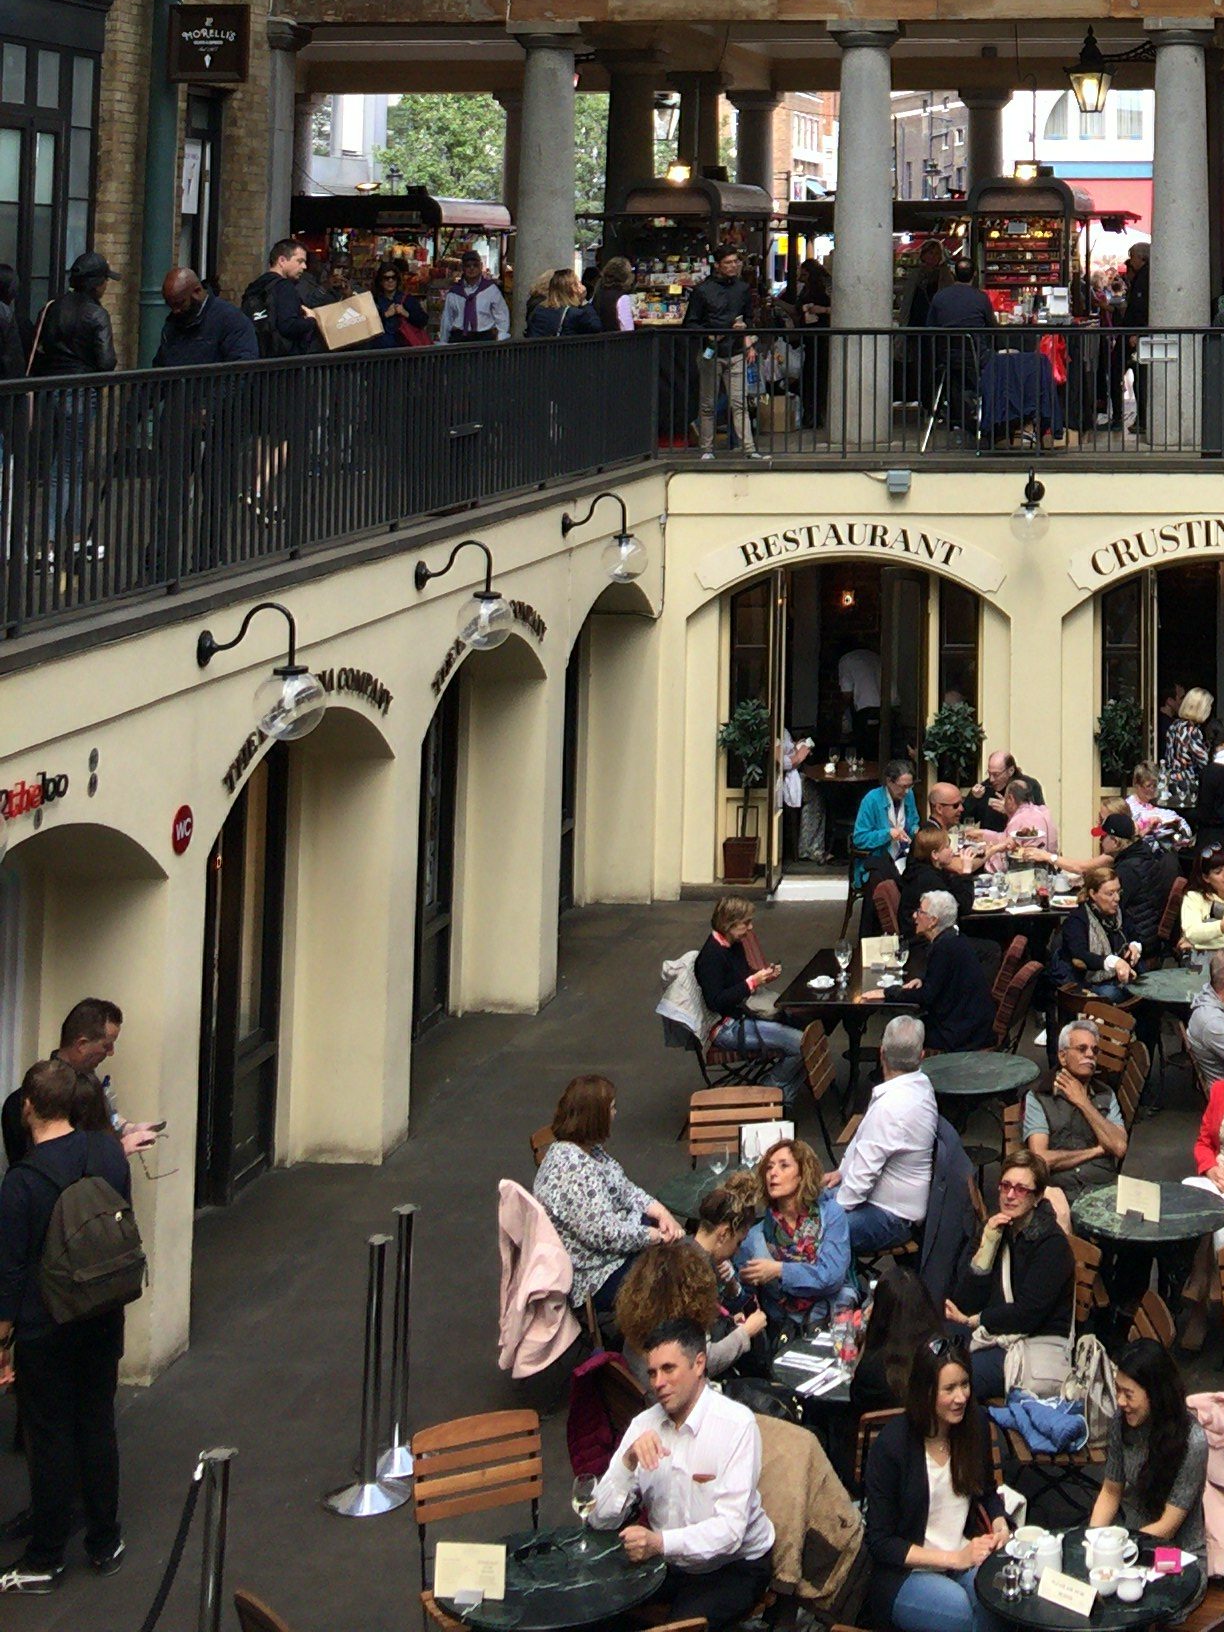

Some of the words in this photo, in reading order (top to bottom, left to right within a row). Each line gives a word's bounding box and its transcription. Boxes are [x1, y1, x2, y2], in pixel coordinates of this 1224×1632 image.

[737, 523, 963, 567] RESTAURANT
[336, 667, 394, 716] COMPANY
[176, 818, 191, 840] WC
